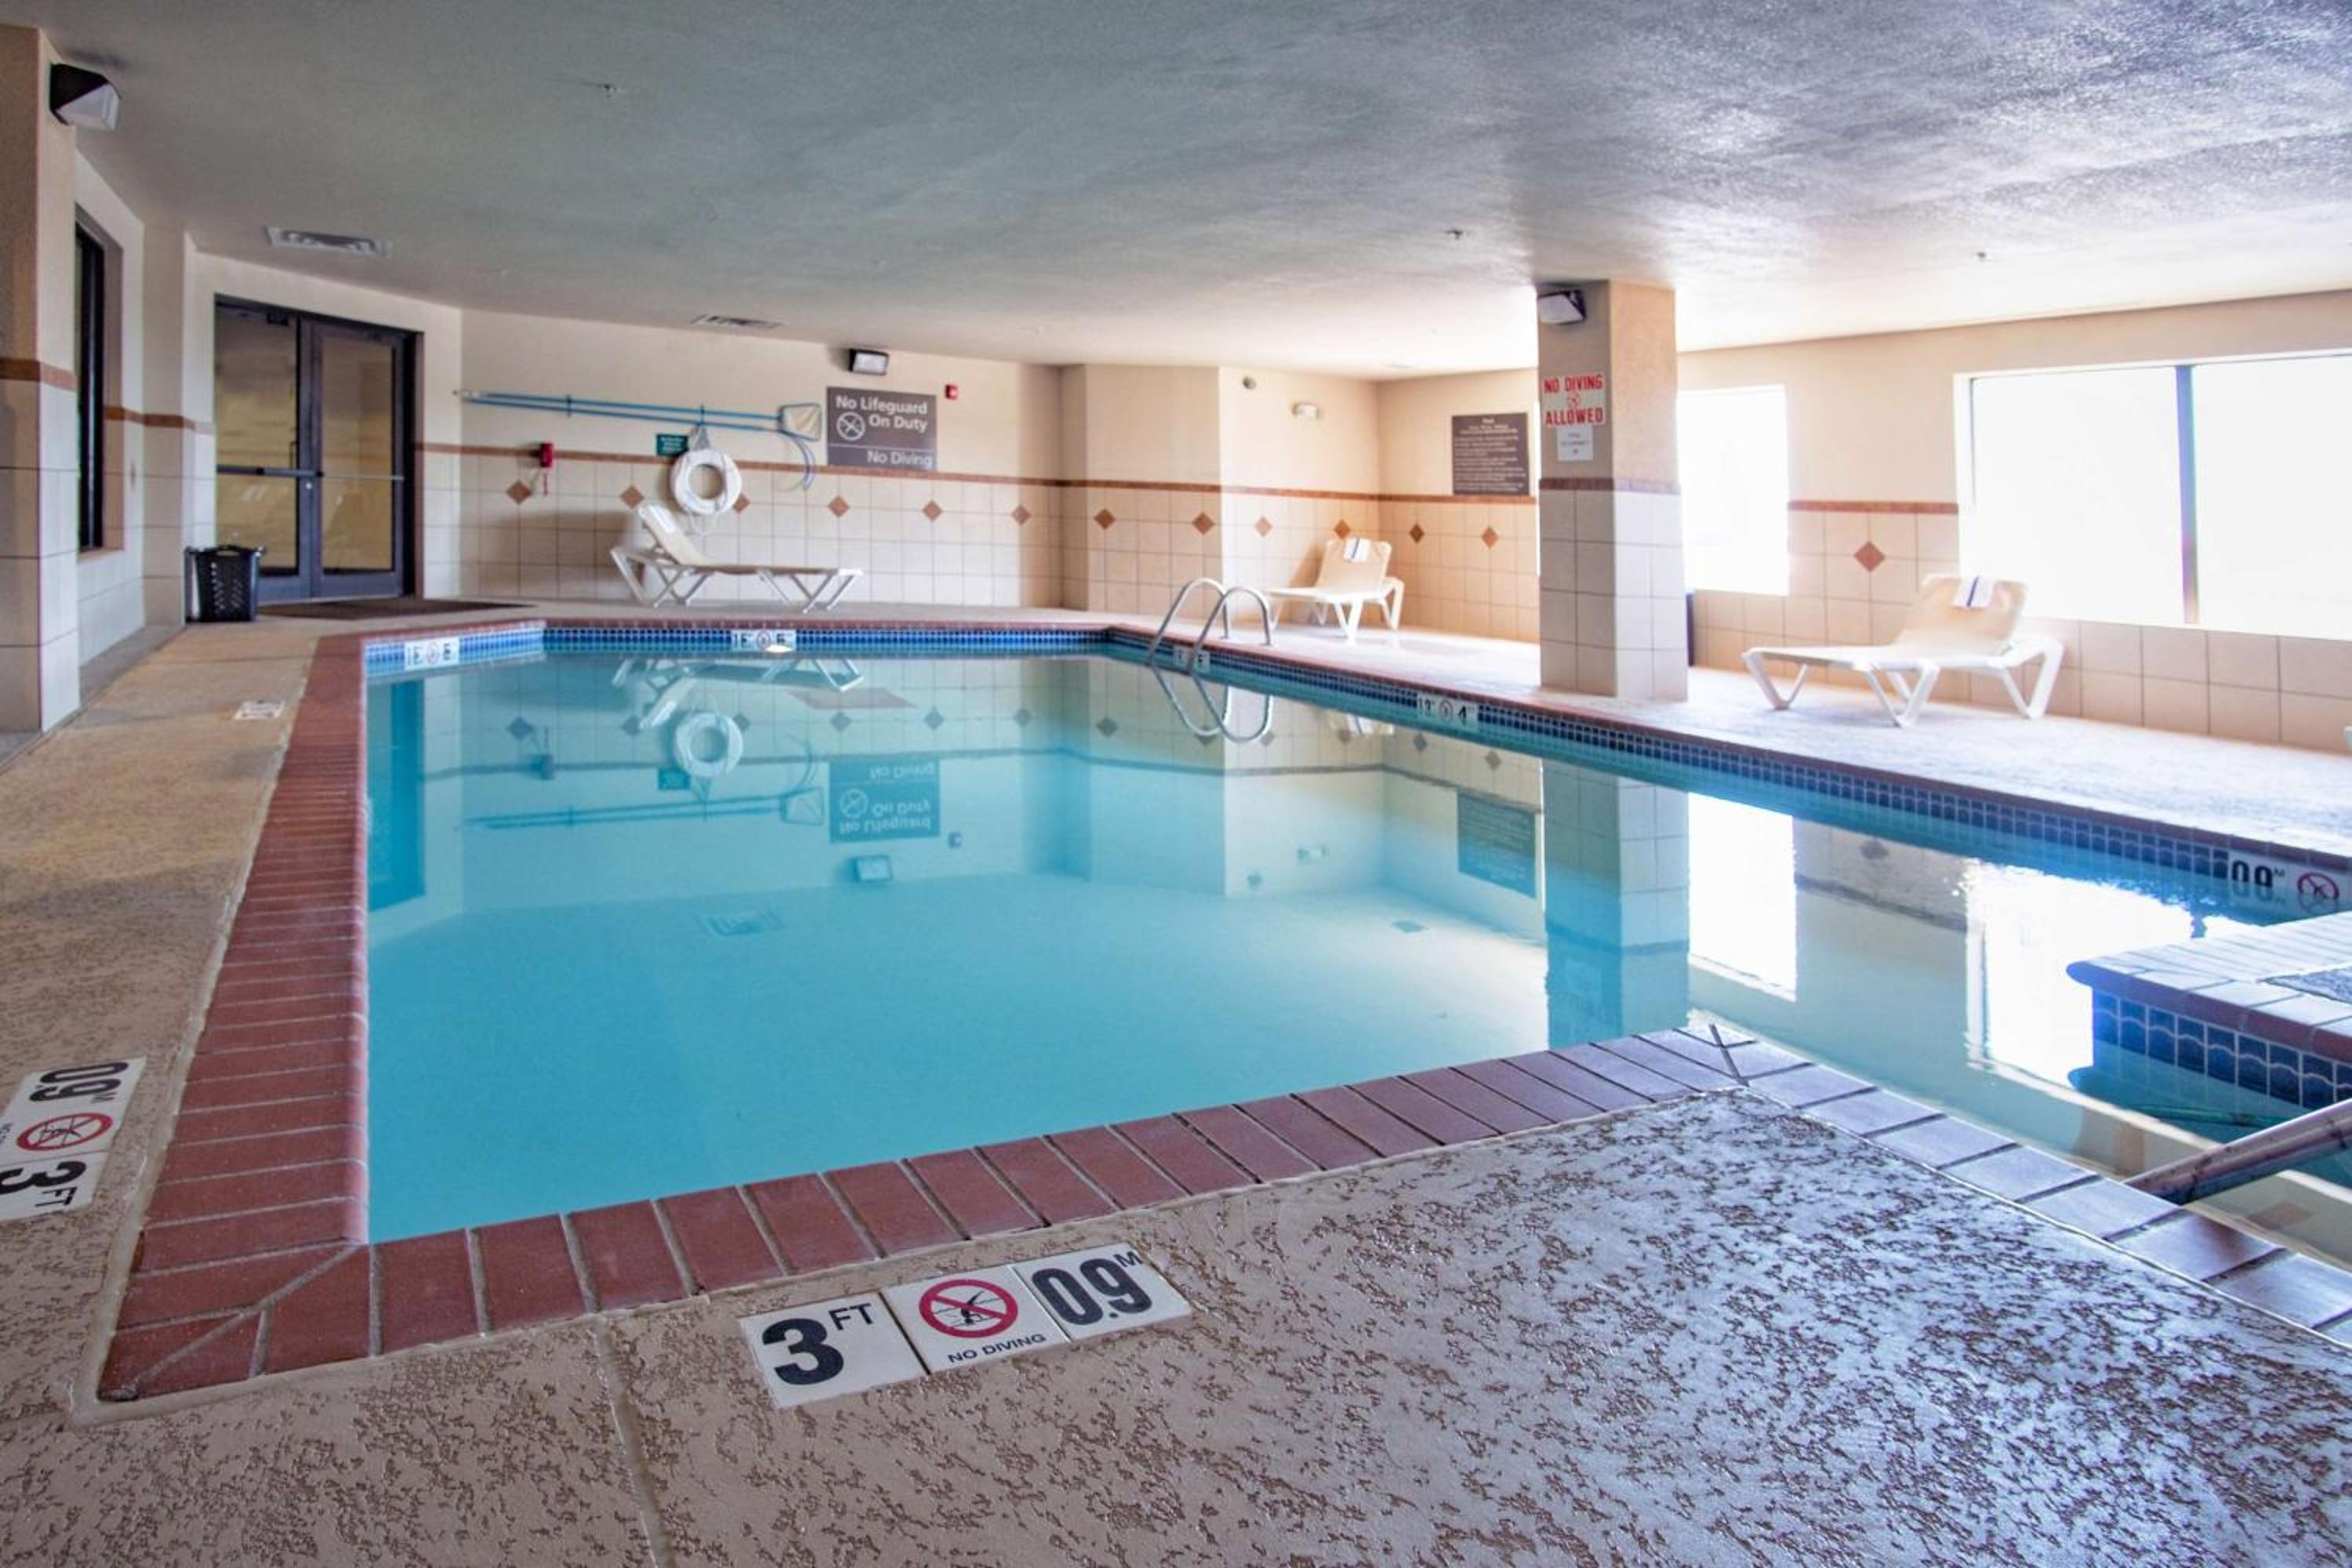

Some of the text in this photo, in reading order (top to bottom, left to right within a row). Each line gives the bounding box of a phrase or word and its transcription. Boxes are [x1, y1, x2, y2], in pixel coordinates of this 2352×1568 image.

[1543, 374, 1603, 394] NO DIVING
[836, 395, 928, 415] No Lifeguard
[869, 414, 928, 434] On Duty
[1545, 407, 1603, 425] ALLOWED
[867, 450, 933, 468] No Diving
[34, 1185, 78, 1208] FT
[1029, 1250, 1153, 1327] 0.9 M
[761, 1301, 875, 1386] 3 FT
[947, 1333, 1047, 1363] NO DIVING
